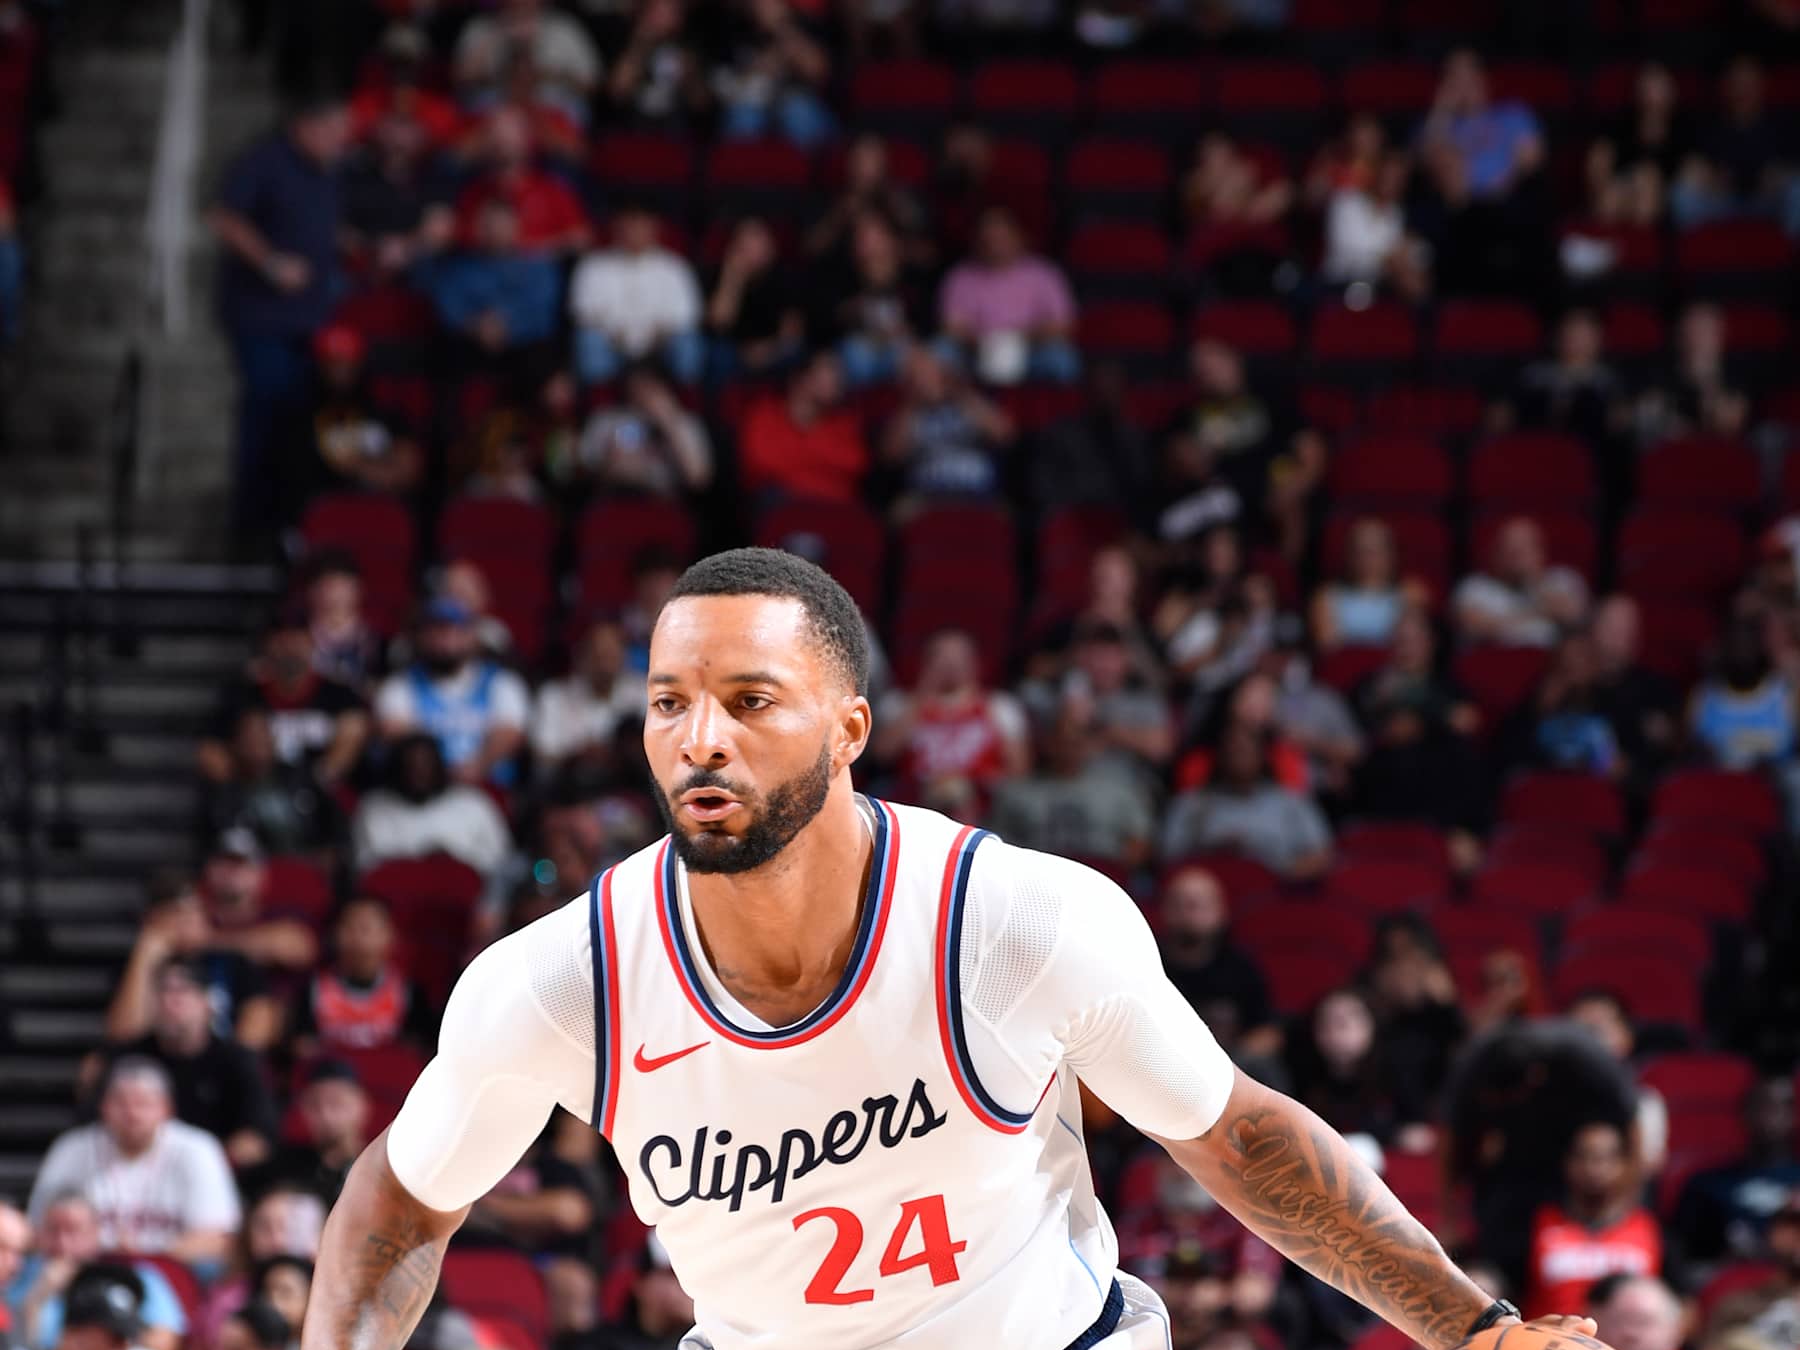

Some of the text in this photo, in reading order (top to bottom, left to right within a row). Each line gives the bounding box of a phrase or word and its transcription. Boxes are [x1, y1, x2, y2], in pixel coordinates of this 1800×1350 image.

[639, 1077, 948, 1212] Clippers
[792, 1193, 967, 1305] 24
[1242, 1135, 1472, 1346] Unshakeable
